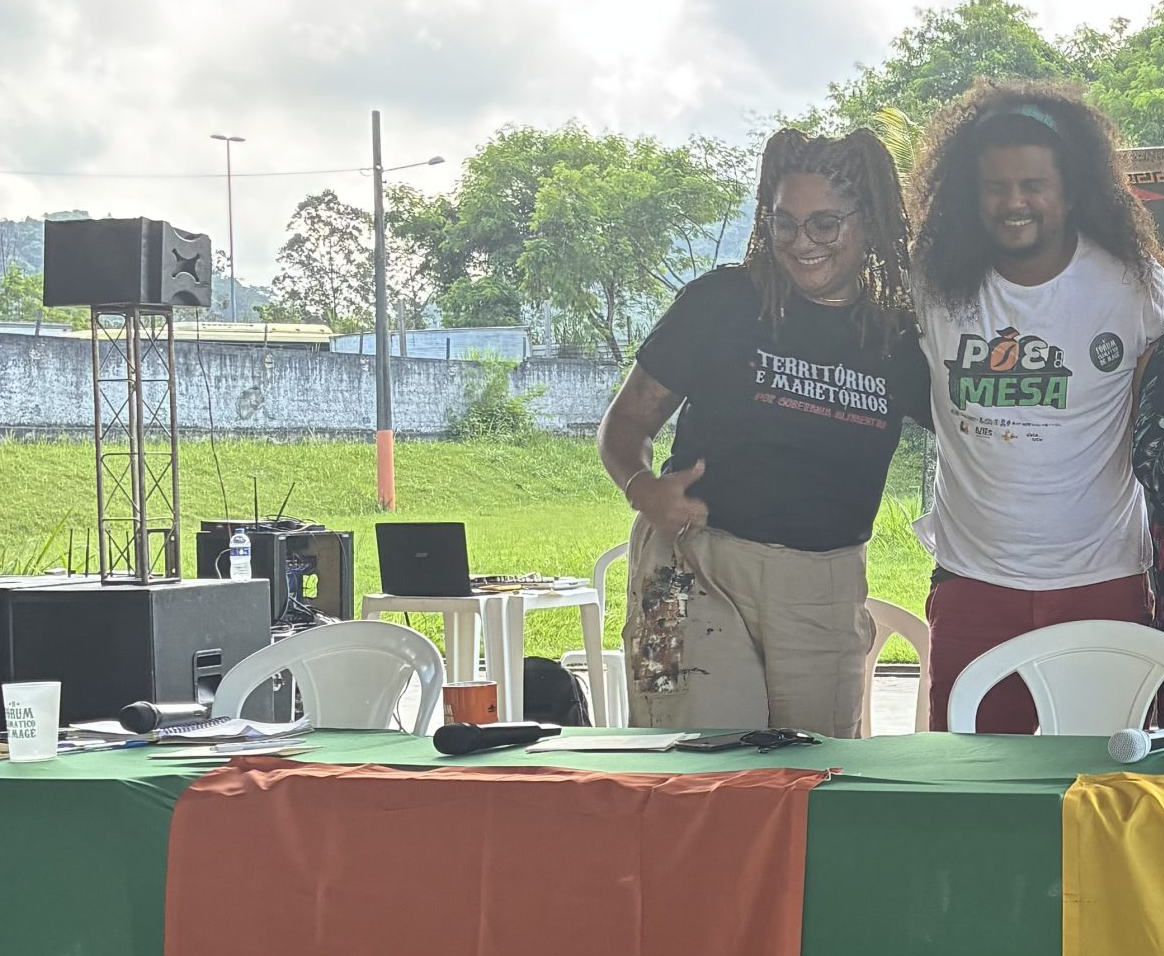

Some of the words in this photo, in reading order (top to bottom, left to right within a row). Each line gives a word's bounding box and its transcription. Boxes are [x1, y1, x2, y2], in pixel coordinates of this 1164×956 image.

[755, 370, 766, 384] E
[771, 374, 888, 415] MARETÓRIOS
[757, 349, 886, 396] TERRITÓRIOS
[959, 376, 1067, 410] MESA
